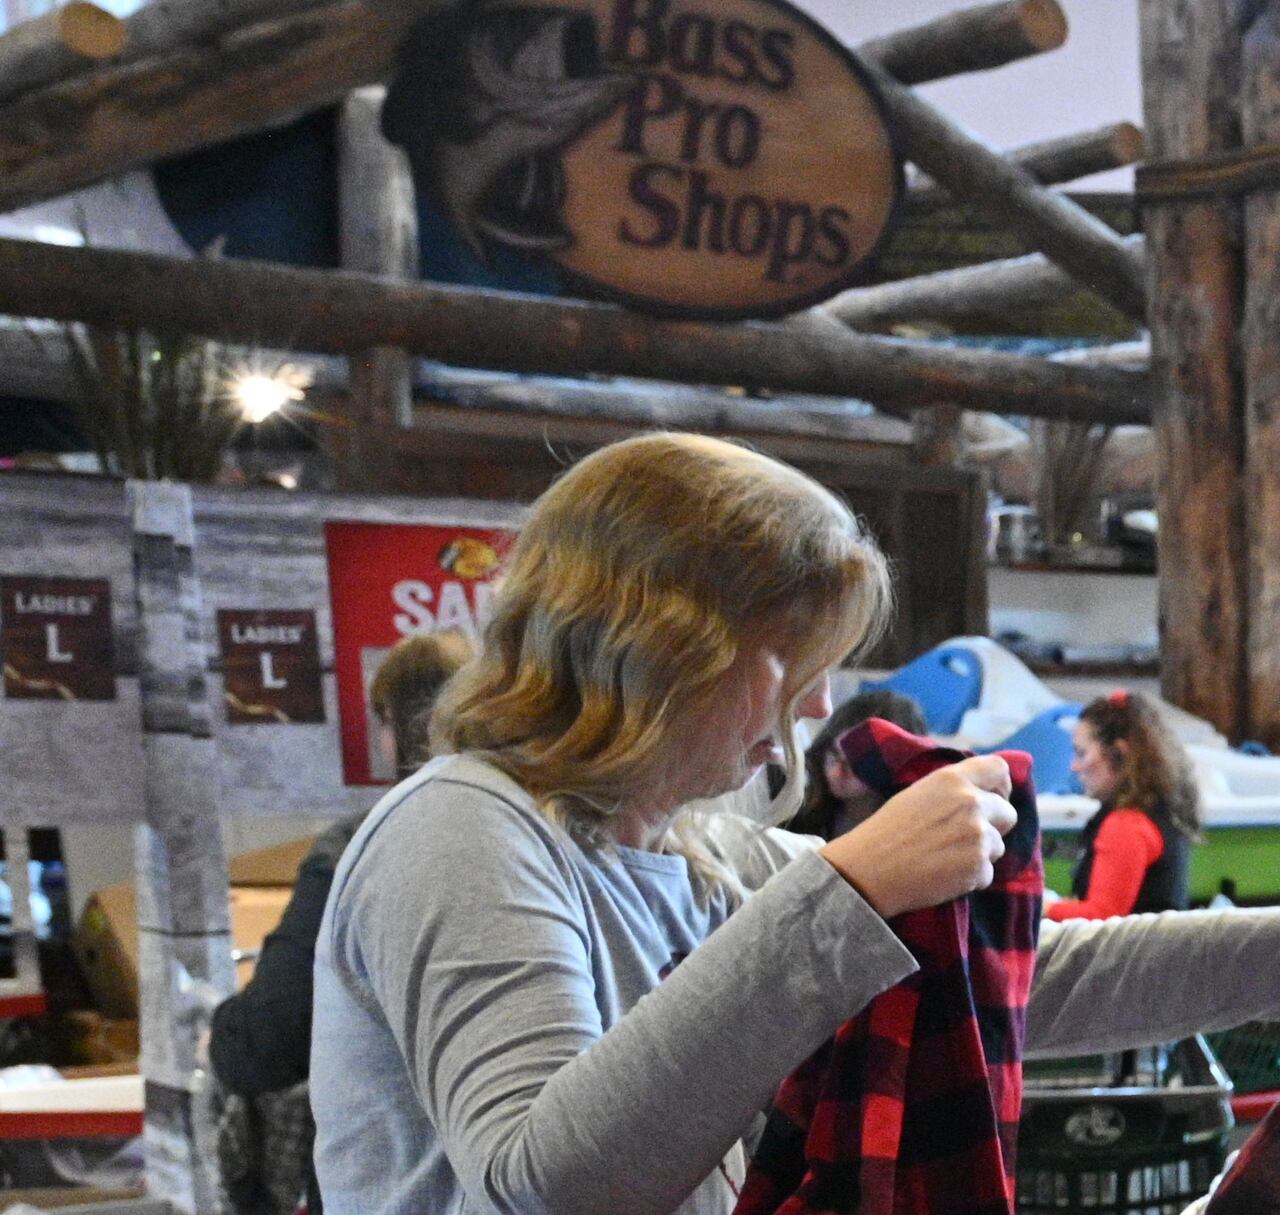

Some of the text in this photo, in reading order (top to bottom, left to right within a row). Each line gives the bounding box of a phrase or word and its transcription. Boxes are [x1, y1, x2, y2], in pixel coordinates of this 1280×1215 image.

[609, 0, 795, 91] Bass
[616, 72, 760, 169] Pro
[618, 162, 851, 282] Shops
[46, 623, 73, 663] L
[259, 651, 288, 689] L
